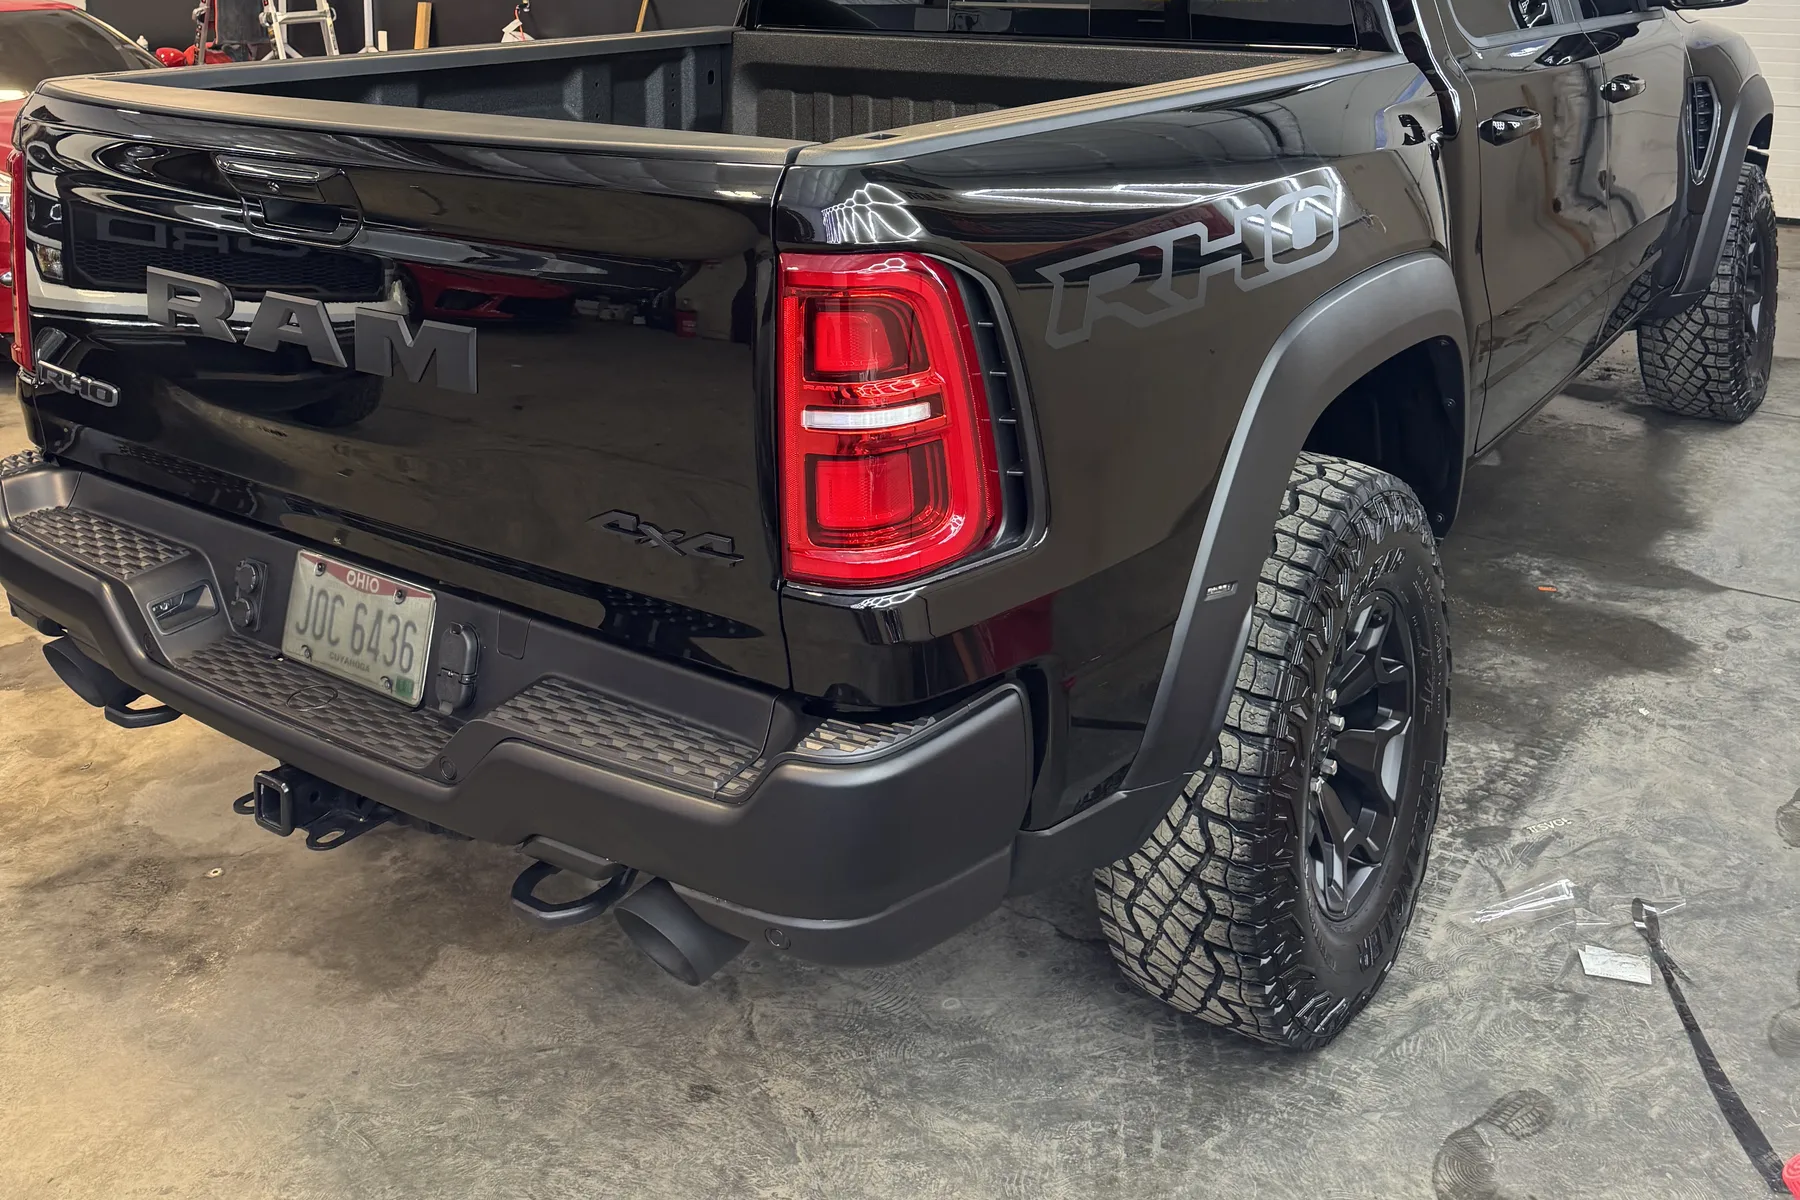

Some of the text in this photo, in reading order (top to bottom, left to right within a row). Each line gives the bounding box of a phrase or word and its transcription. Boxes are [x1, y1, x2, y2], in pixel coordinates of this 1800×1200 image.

[1035, 185, 1340, 350] RHO
[146, 266, 478, 394] RAM
[38, 360, 121, 408] RHO
[346, 570, 380, 593] OHIO
[295, 585, 417, 674] JOC 6436
[329, 651, 371, 673] CUYAHOGA
